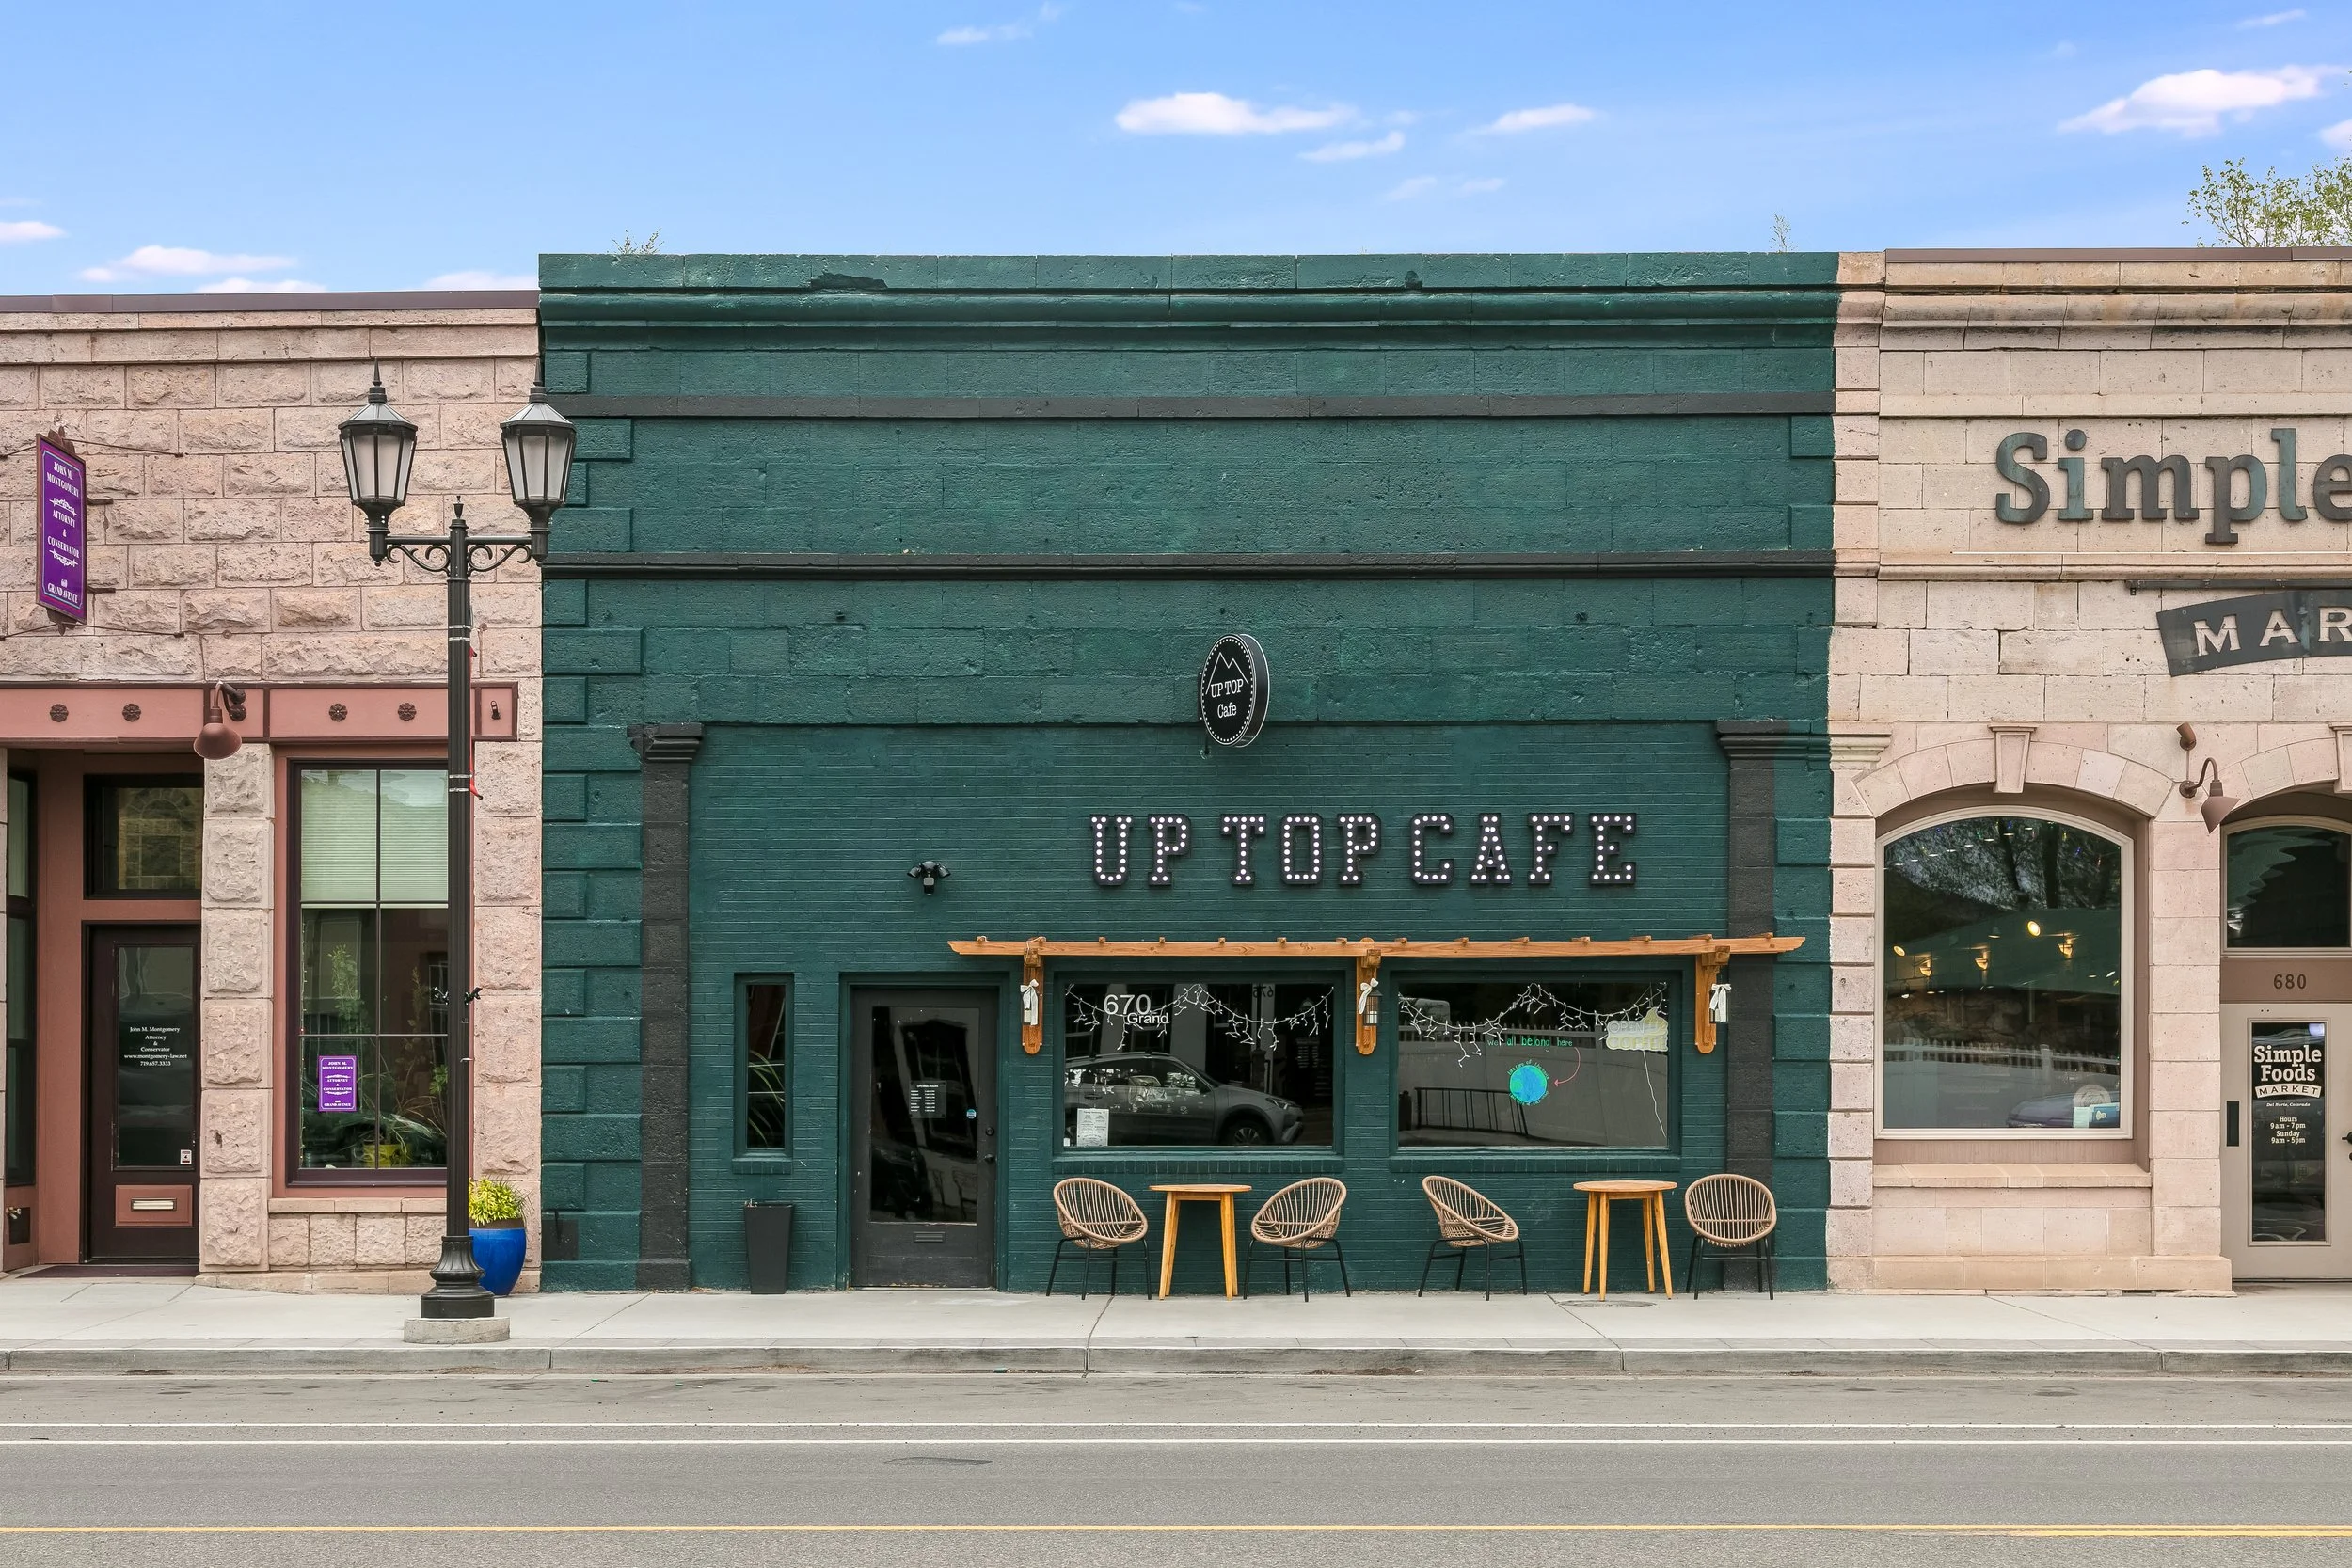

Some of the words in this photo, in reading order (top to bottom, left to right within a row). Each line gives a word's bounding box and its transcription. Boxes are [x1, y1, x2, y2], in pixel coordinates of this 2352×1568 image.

[53, 461, 67, 476] JOHN
[47, 472, 79, 497] MONTGOMERY
[1995, 427, 2352, 544] Simple
[53, 510, 75, 527] ATTORNEY
[47, 536, 79, 559] CONSERVATOR
[48, 583, 63, 596] GRAND
[64, 591, 78, 604] AVENUE
[1211, 683, 1223, 698] UP
[1225, 679, 1244, 695] TOP
[1217, 702, 1236, 719] Cafe
[1089, 813, 1191, 886] UP
[1220, 813, 1382, 886] TOP
[1412, 812, 1639, 885] CAFE
[2273, 974, 2307, 990] 680
[1104, 994, 1151, 1015] 670
[1127, 1012, 1168, 1024] Grand
[1609, 1022, 1645, 1034] OPEN
[1507, 1035, 1516, 1046] all
[1521, 1035, 1550, 1052] belong
[1557, 1037, 1573, 1046] here
[2254, 1045, 2322, 1067] Simple
[2261, 1064, 2316, 1082] Foods
[2259, 1085, 2318, 1095] MARKET
